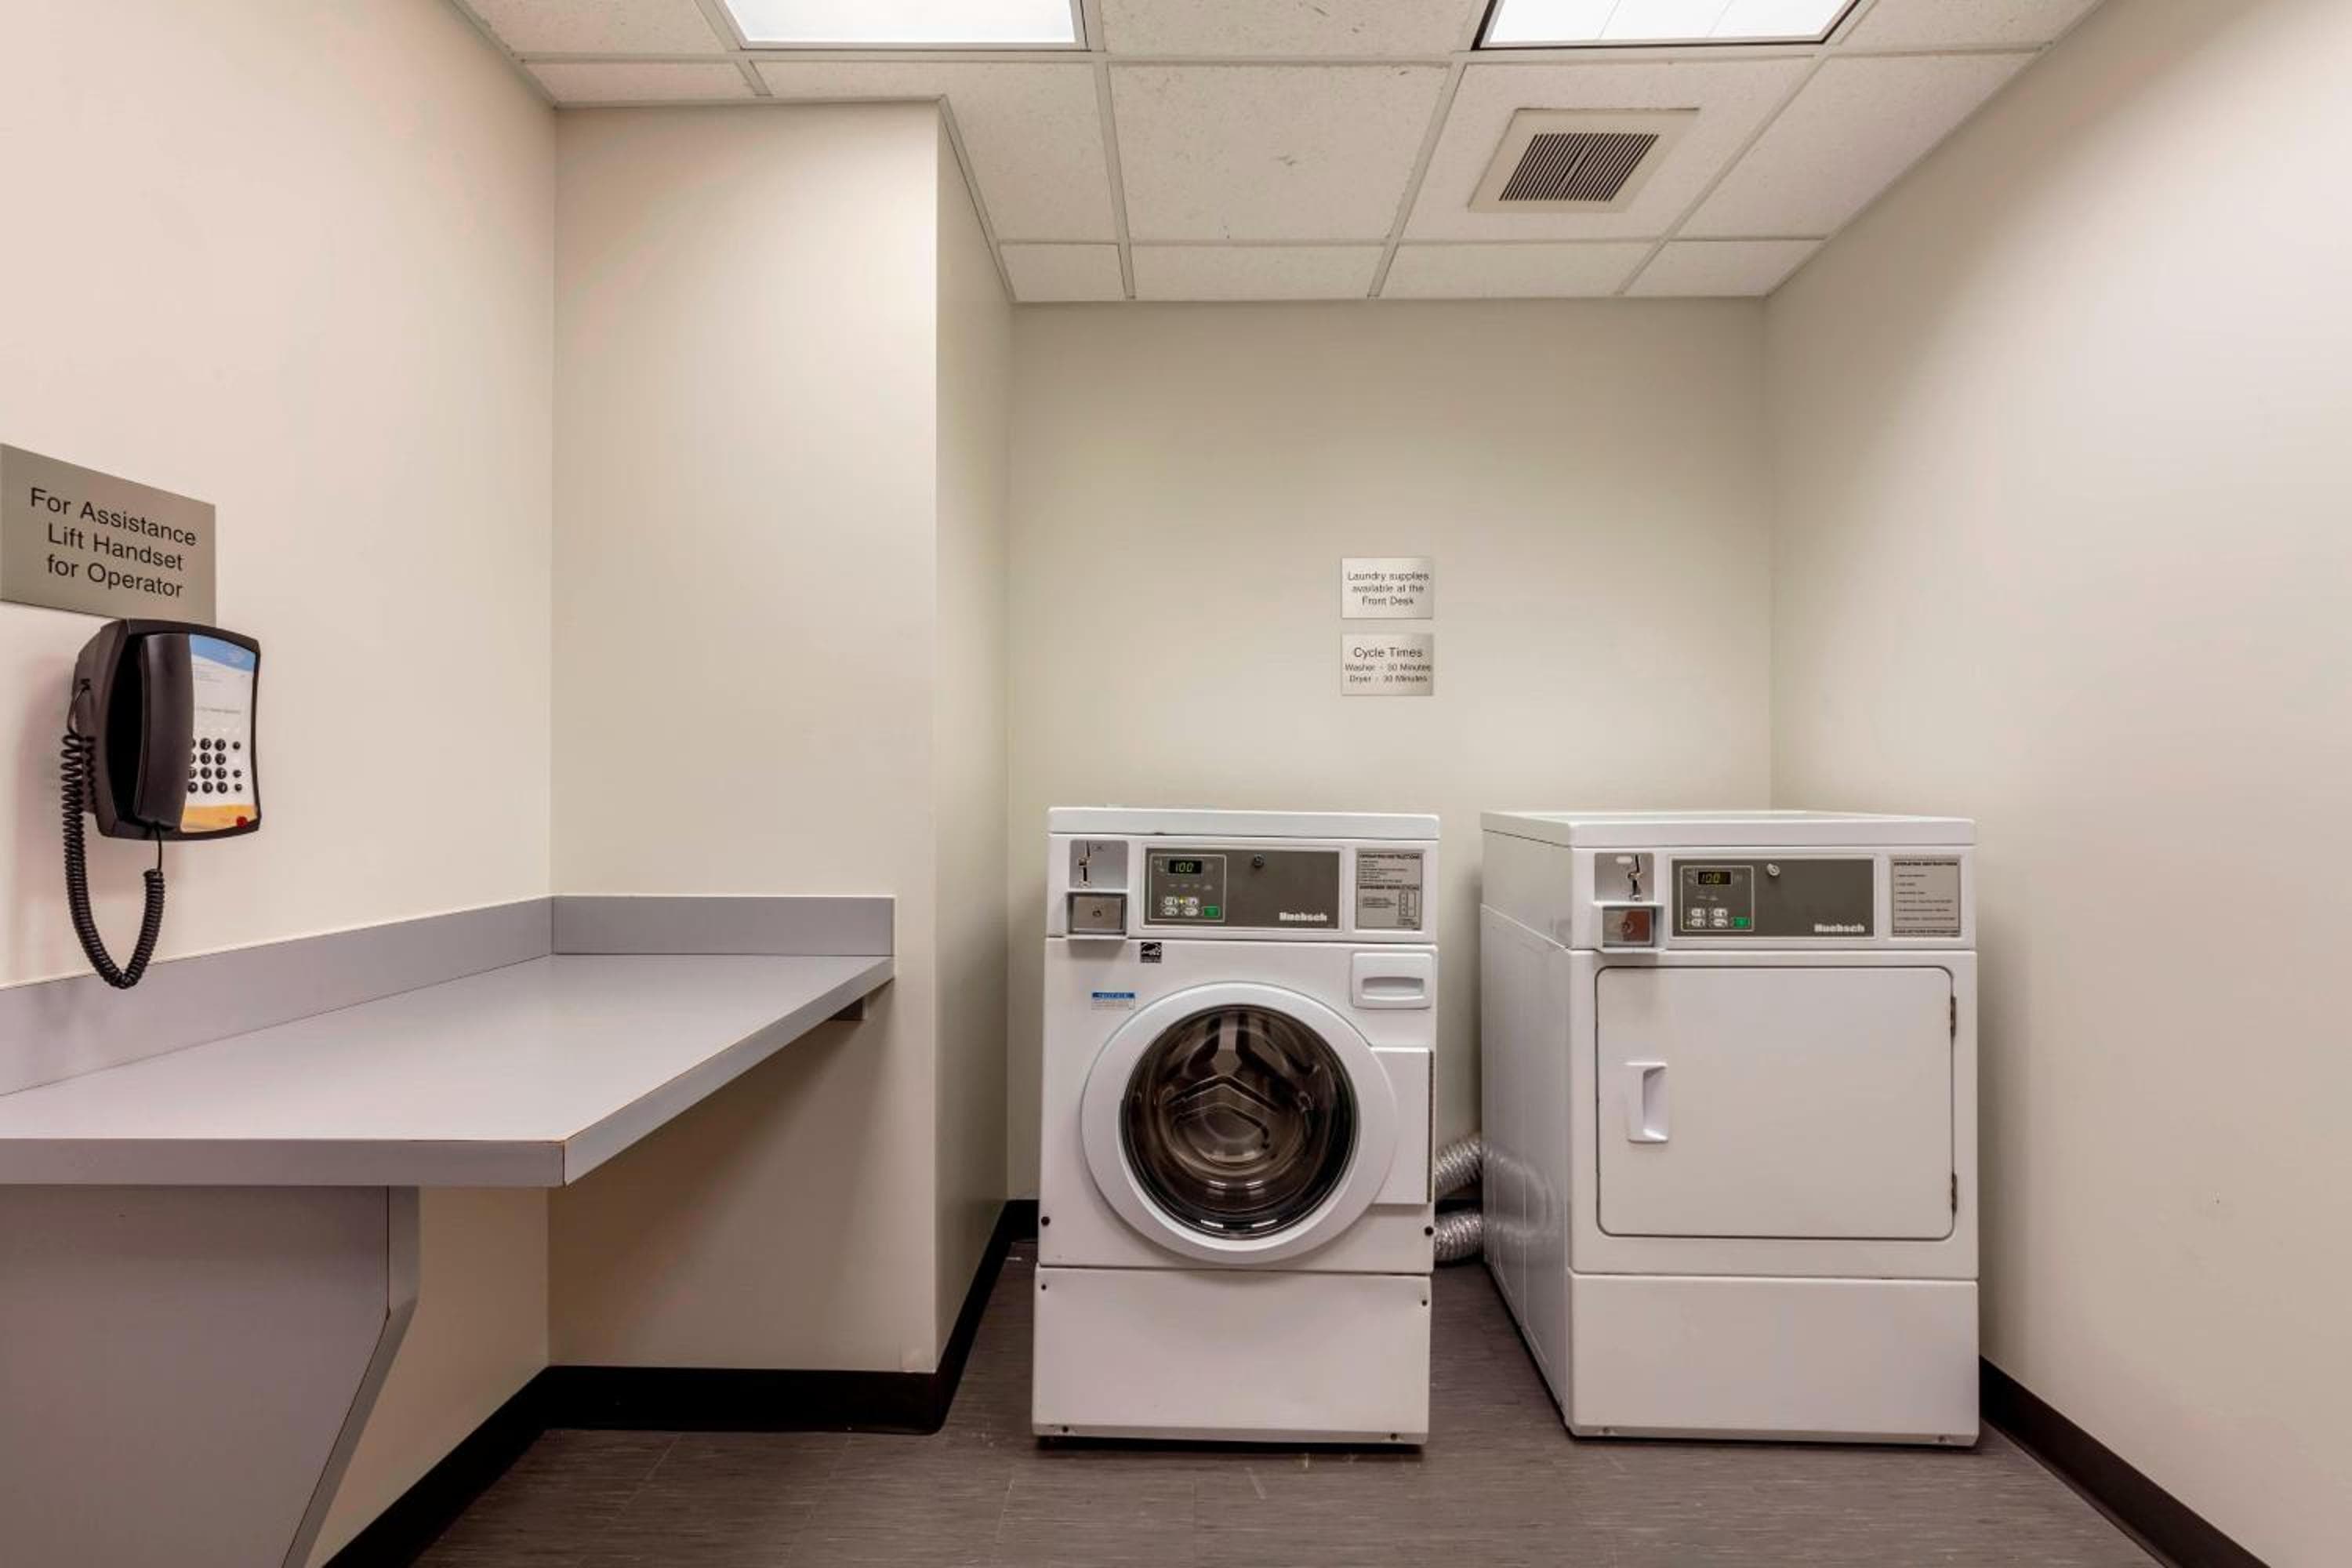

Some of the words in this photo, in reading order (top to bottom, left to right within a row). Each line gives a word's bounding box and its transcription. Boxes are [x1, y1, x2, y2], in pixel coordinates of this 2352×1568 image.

[30, 486, 71, 515] For
[80, 501, 197, 546] Assistance
[47, 522, 84, 550] Lift
[93, 533, 183, 572] Handset
[46, 554, 79, 578] for
[87, 562, 183, 598] Operator
[1348, 572, 1387, 582] Laundry
[1389, 572, 1430, 582] supplies
[1352, 584, 1393, 593] available
[1409, 584, 1425, 593] the
[1362, 596, 1387, 605] Front
[1390, 596, 1414, 605] Desk
[1353, 647, 1385, 659] Cycle
[1388, 647, 1423, 658] Times
[1345, 663, 1375, 672] Washer
[1399, 663, 1432, 672] Minutes
[1349, 675, 1372, 684] Dryer
[1174, 862, 1195, 873] 100
[1279, 911, 1328, 922] Huebsch
[1814, 923, 1865, 933] Huebsch
